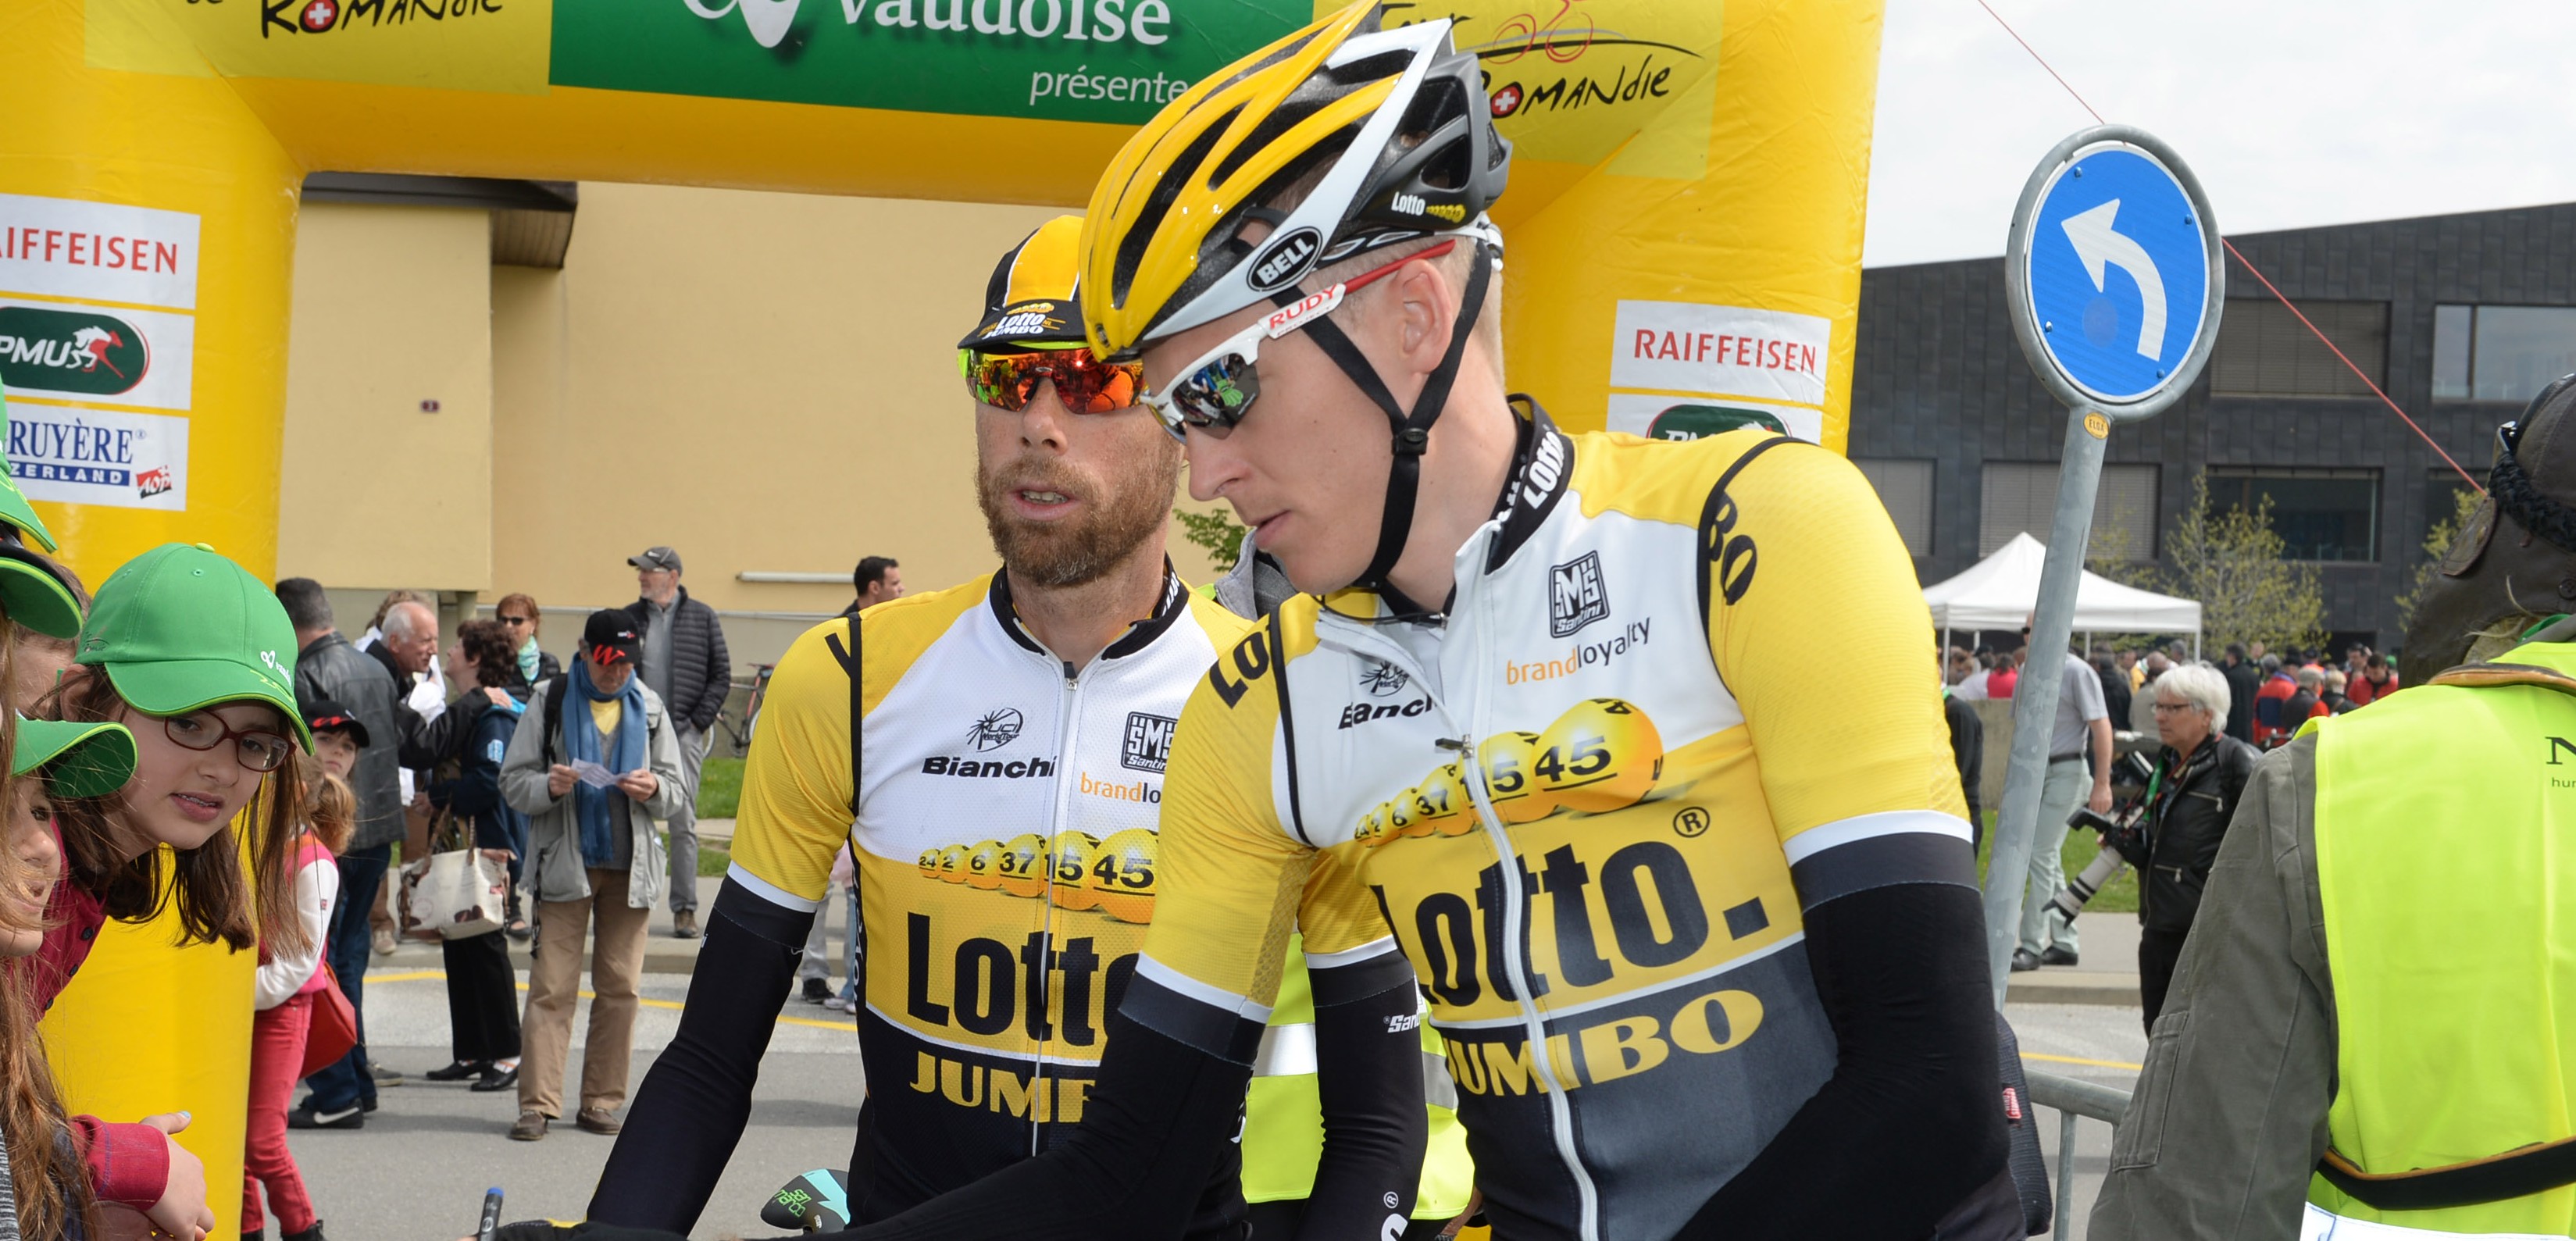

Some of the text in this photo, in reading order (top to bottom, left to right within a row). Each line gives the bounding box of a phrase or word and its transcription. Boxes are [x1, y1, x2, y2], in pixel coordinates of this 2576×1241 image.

[841, 0, 1171, 45] vaudoise
[1029, 65, 1188, 106] présente
[1391, 192, 1425, 216] Lotto
[0, 226, 177, 275] IFFEISEN
[1257, 237, 1314, 285] BELL
[1269, 284, 1337, 330] RUDY
[1634, 329, 1816, 375] RAIFFEISEN
[7, 418, 134, 464] RUYÈRE
[9, 462, 123, 484] ZERLAND
[1507, 616, 1650, 686] brandloyalty
[988, 723, 1018, 733] UCI
[922, 754, 1058, 779] Bianchi
[1080, 771, 1161, 804] brandlo
[1392, 808, 1408, 827] 6
[1415, 789, 1449, 816] 37
[1534, 736, 1611, 783] 45
[919, 851, 1154, 889] 24 2 6 37 15 45
